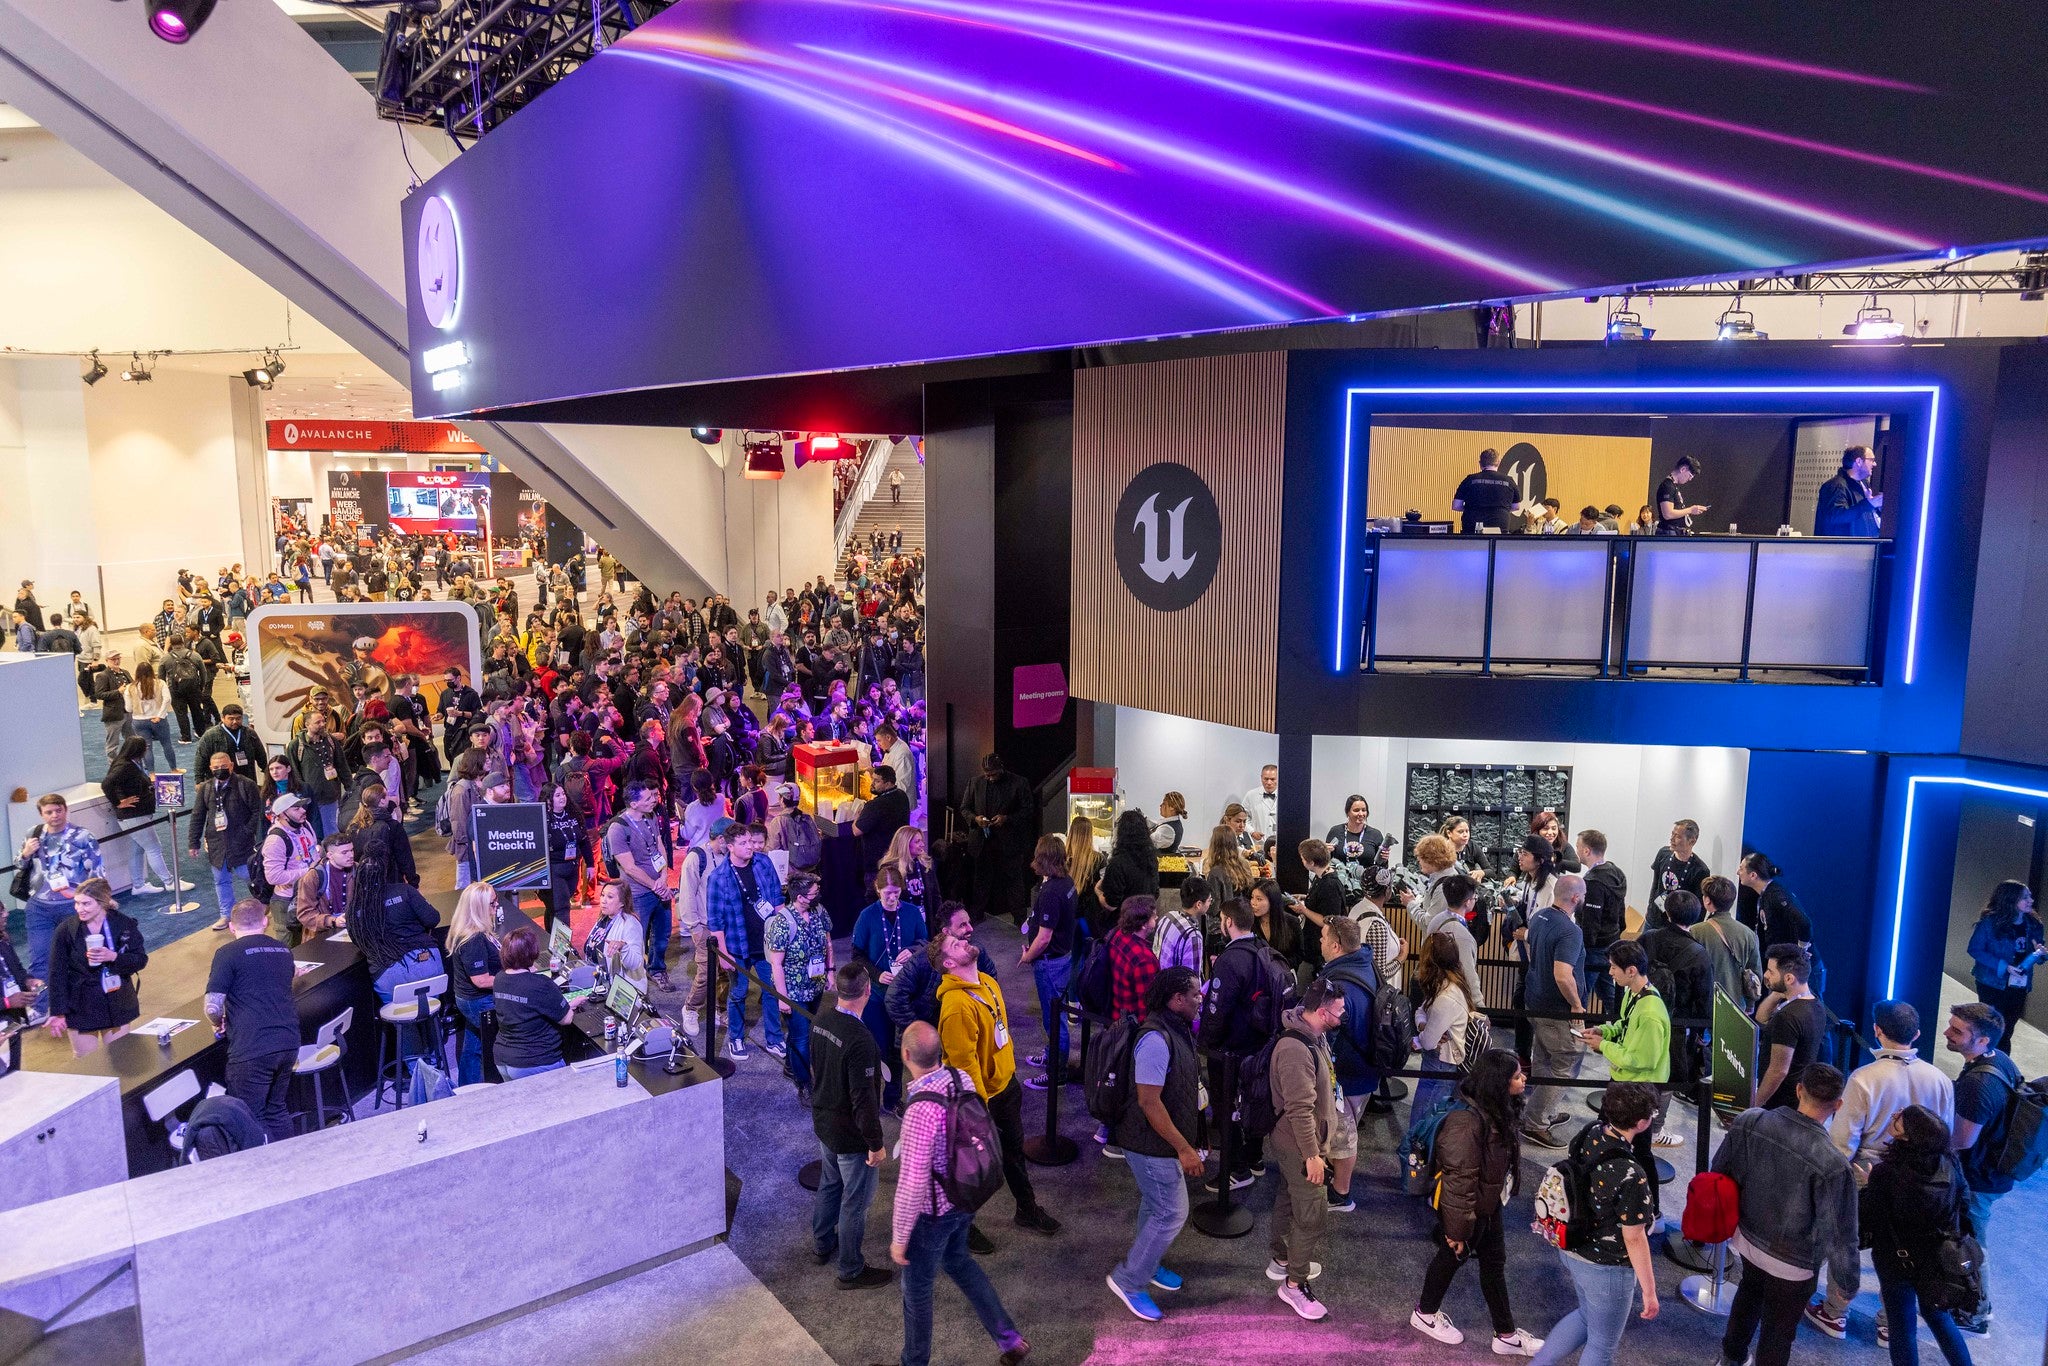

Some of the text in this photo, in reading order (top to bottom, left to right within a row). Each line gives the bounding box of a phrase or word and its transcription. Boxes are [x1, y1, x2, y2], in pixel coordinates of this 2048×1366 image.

[300, 430, 372, 439] AVALANCHE
[447, 430, 475, 443] WE
[336, 500, 357, 508] WEB3
[331, 507, 362, 515] GAMING
[1020, 692, 1045, 701] Meeting
[488, 830, 534, 841] Meeting
[488, 841, 524, 851] Check
[1720, 1038, 1745, 1079] T-shirts
